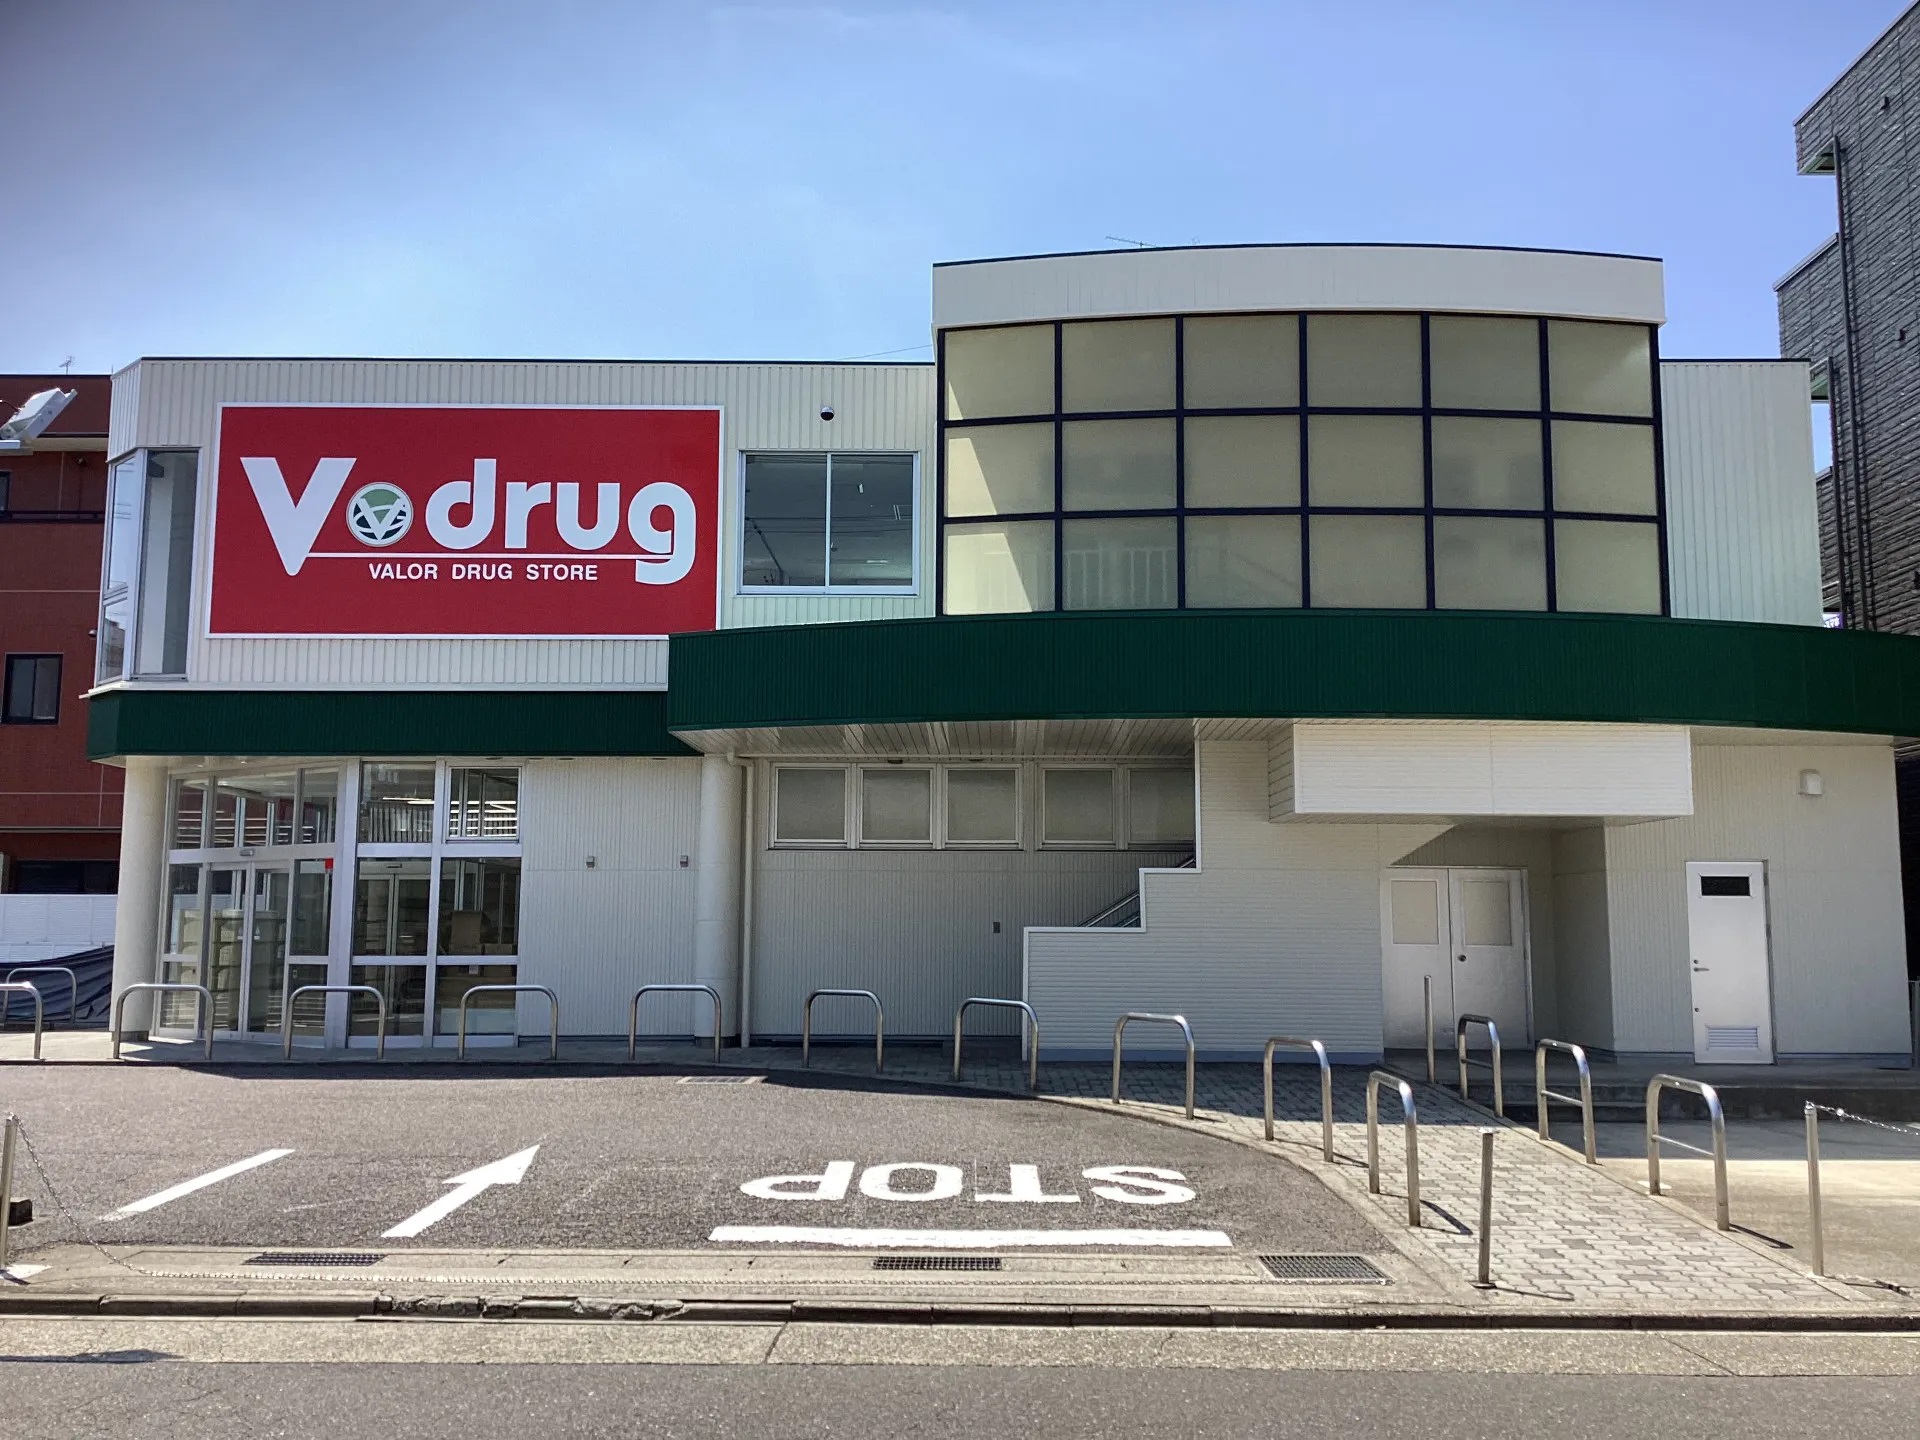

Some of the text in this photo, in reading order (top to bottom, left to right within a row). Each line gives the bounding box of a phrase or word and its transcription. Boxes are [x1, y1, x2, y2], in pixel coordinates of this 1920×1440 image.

[368, 563, 599, 582] VALOR DRUG STORE
[739, 1160, 1197, 1205] STOP
